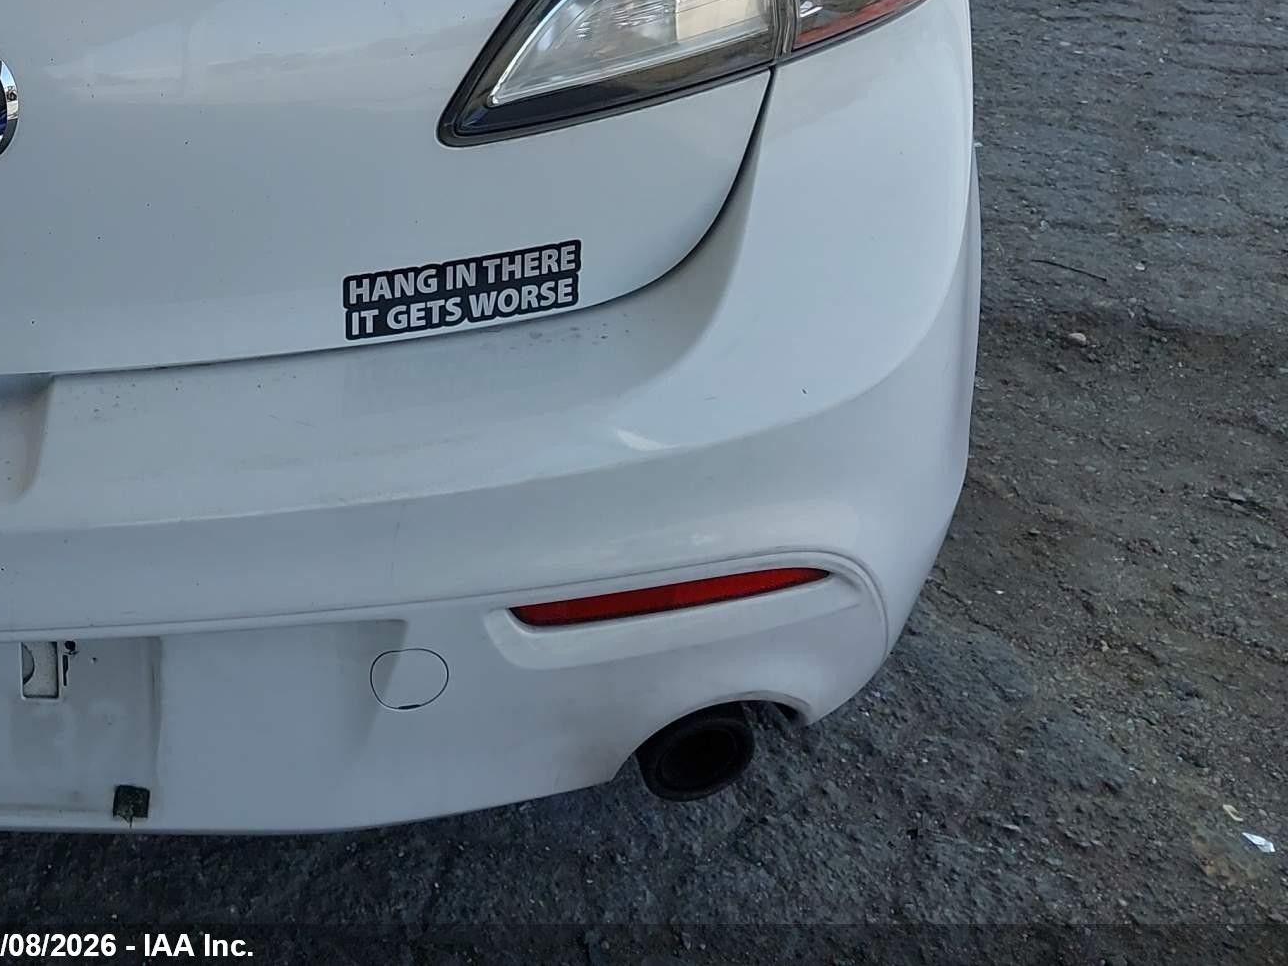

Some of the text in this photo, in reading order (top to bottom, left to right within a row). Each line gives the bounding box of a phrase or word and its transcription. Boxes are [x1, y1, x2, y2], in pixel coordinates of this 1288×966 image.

[348, 244, 577, 305] HANG IN THERE
[350, 277, 574, 336] IT GETS WORSE
